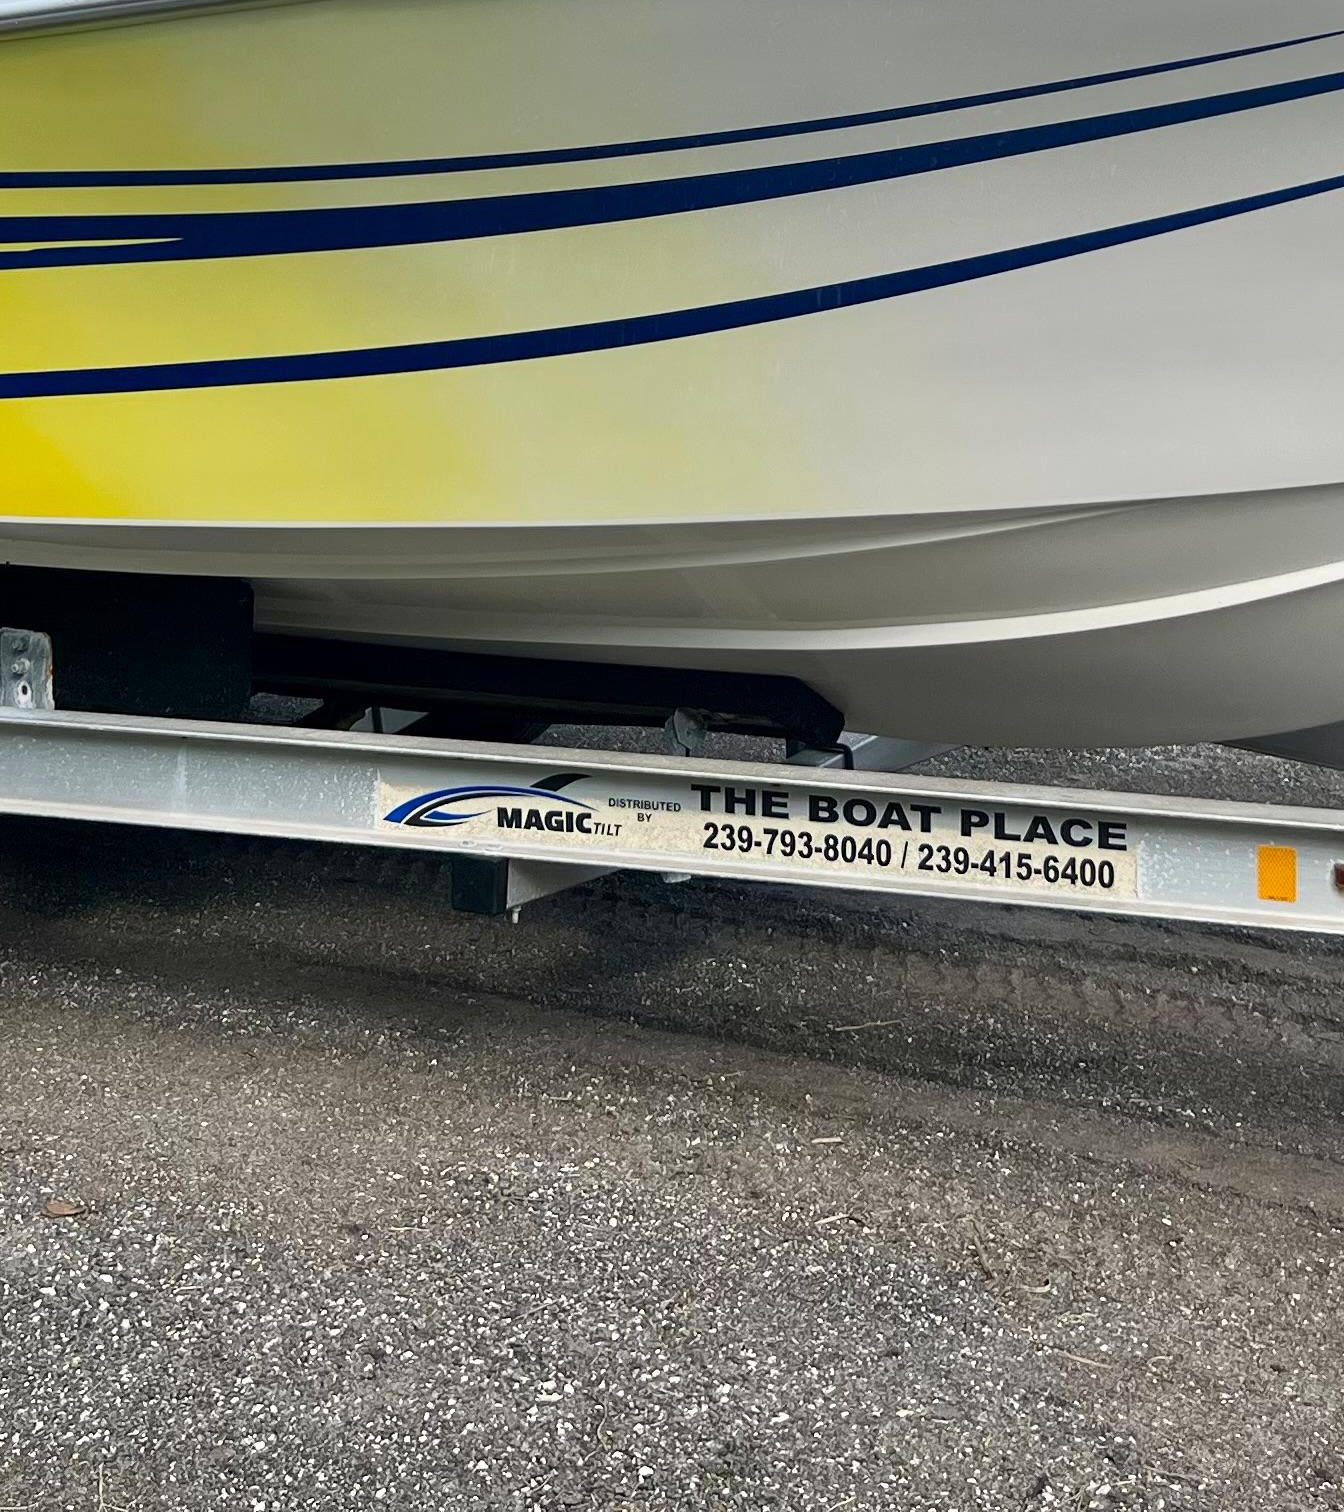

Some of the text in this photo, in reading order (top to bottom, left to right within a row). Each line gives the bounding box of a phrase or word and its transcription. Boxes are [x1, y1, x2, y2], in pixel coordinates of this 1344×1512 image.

[608, 797, 681, 813] DISTRIBUTED
[637, 812, 652, 823] BY
[690, 783, 1128, 851] THE BOAT PLACE
[703, 821, 1115, 889] 239-793-8040 / 239-415-6400
